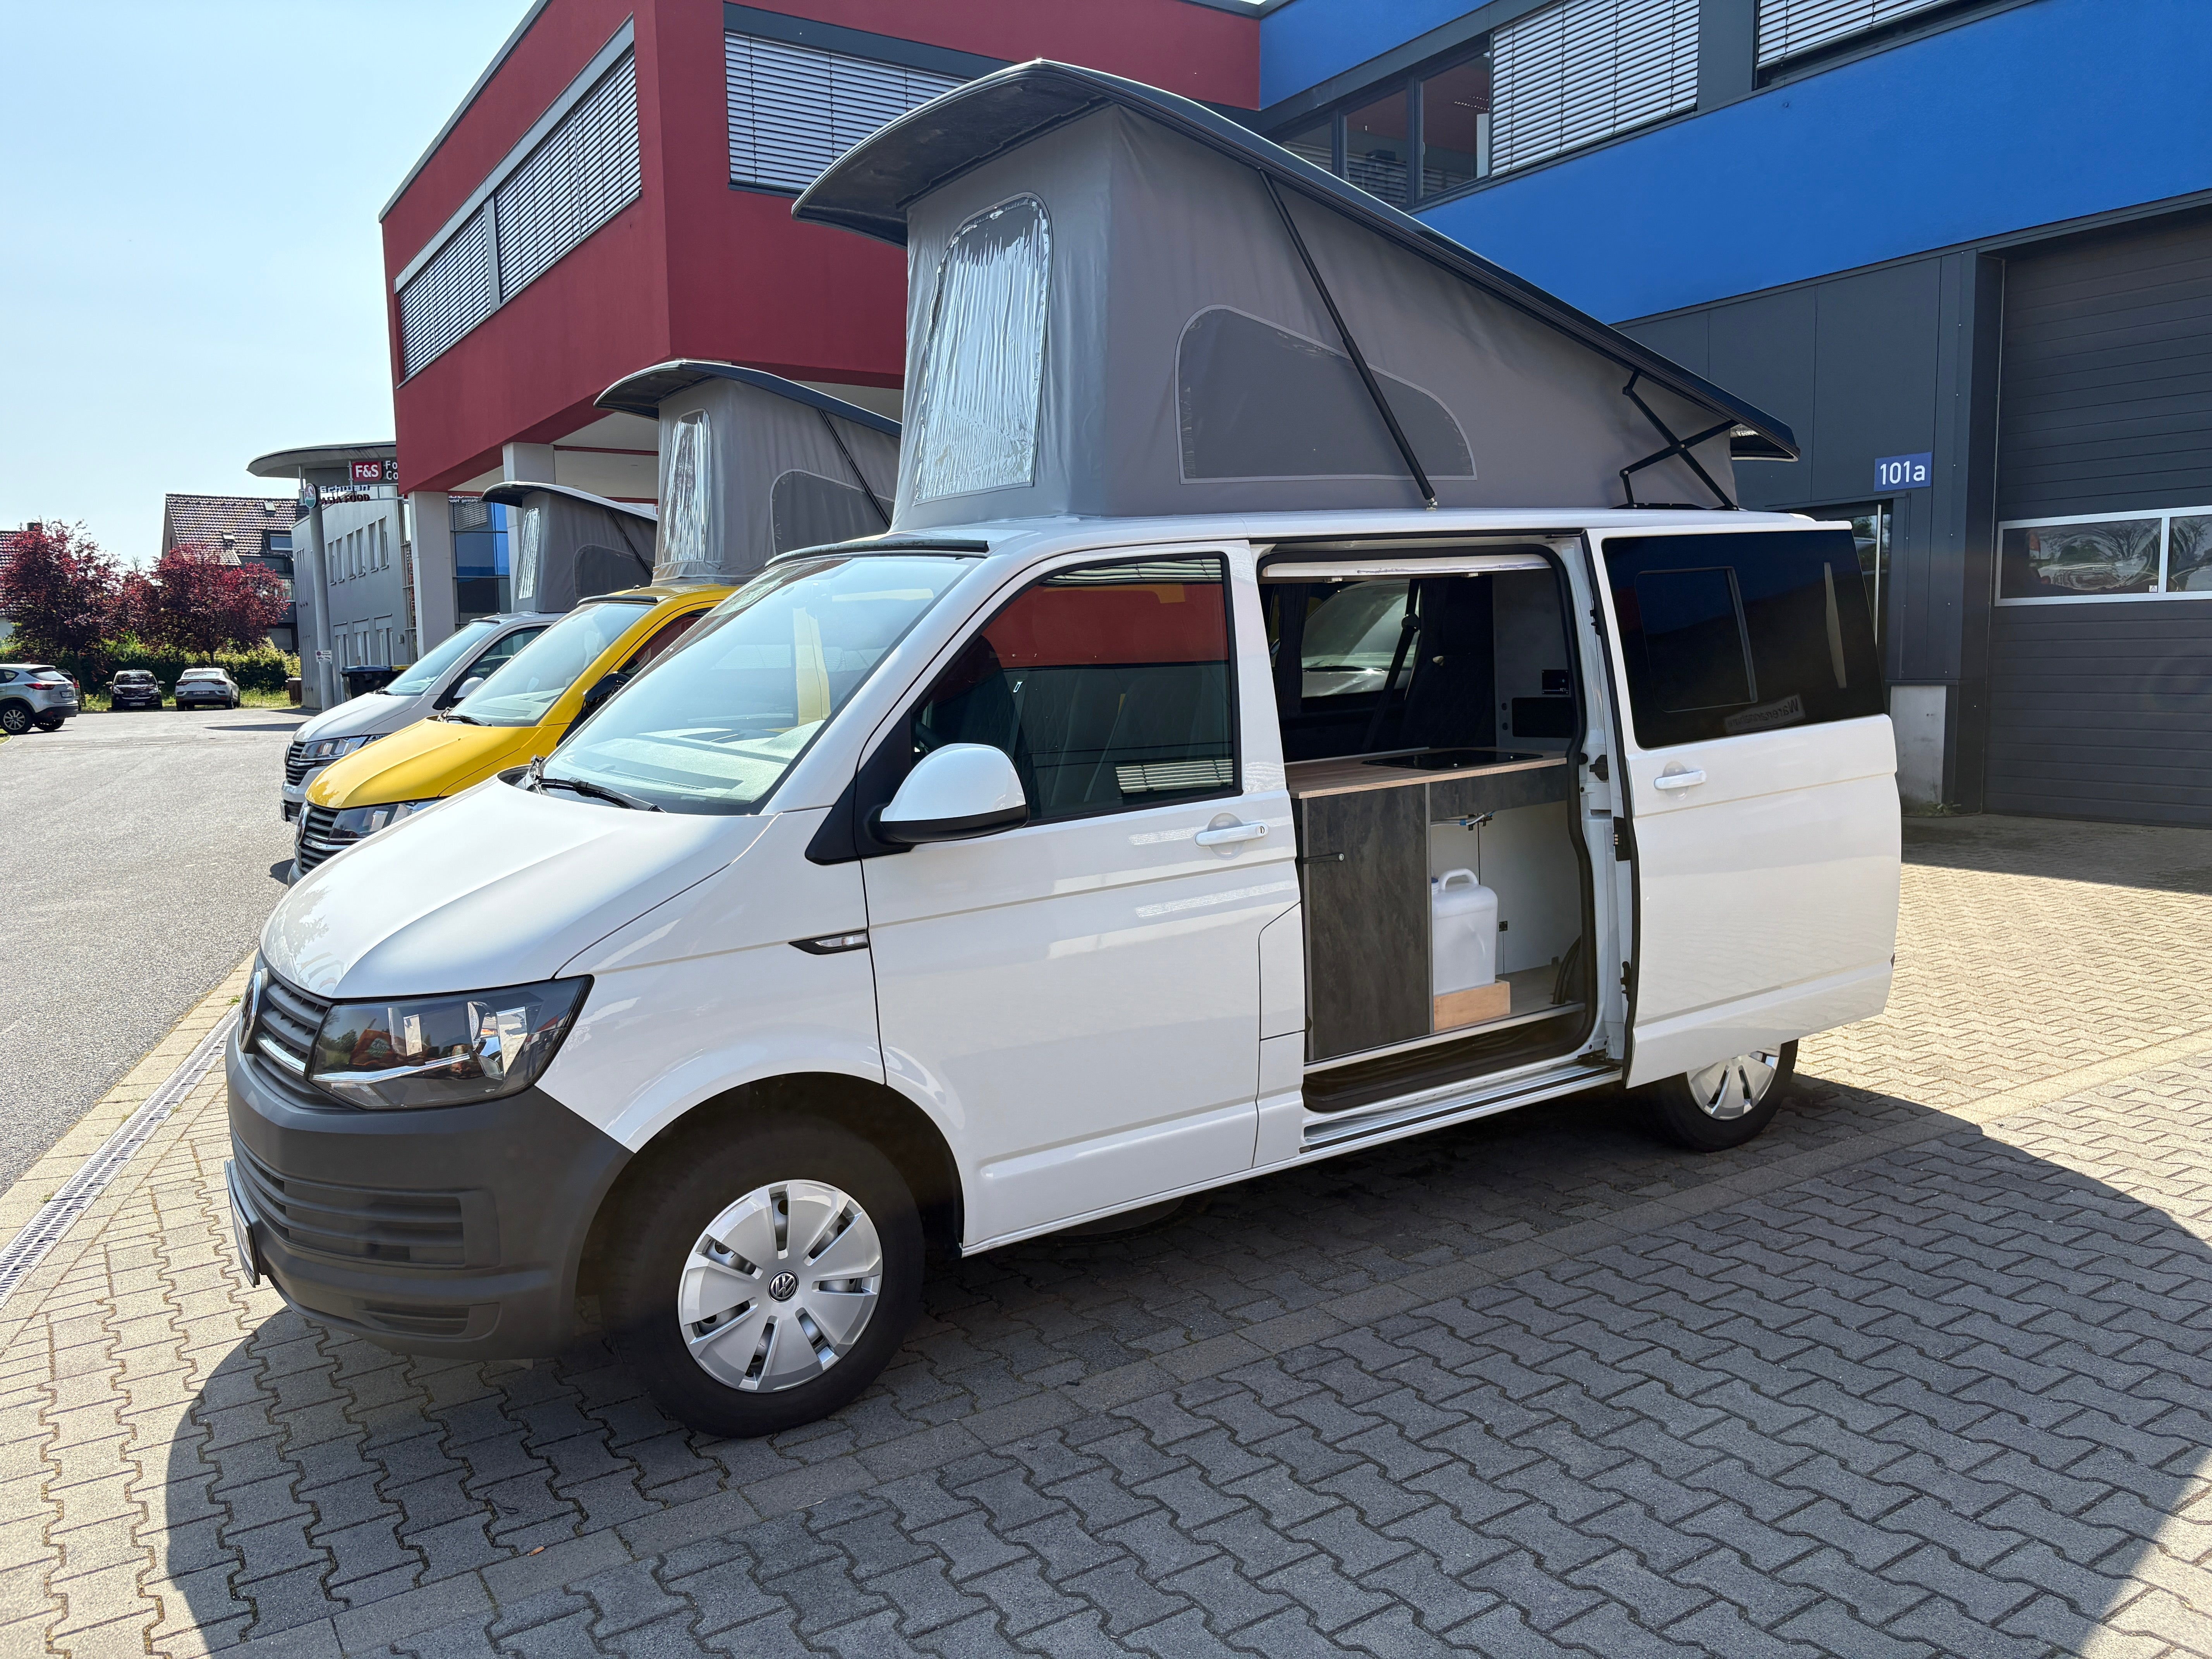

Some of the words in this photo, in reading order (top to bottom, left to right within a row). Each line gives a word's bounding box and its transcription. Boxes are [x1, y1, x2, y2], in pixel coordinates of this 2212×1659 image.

[355, 464, 379, 477] F&S
[1880, 460, 1925, 485] 101a
[344, 494, 370, 503] FOOD
